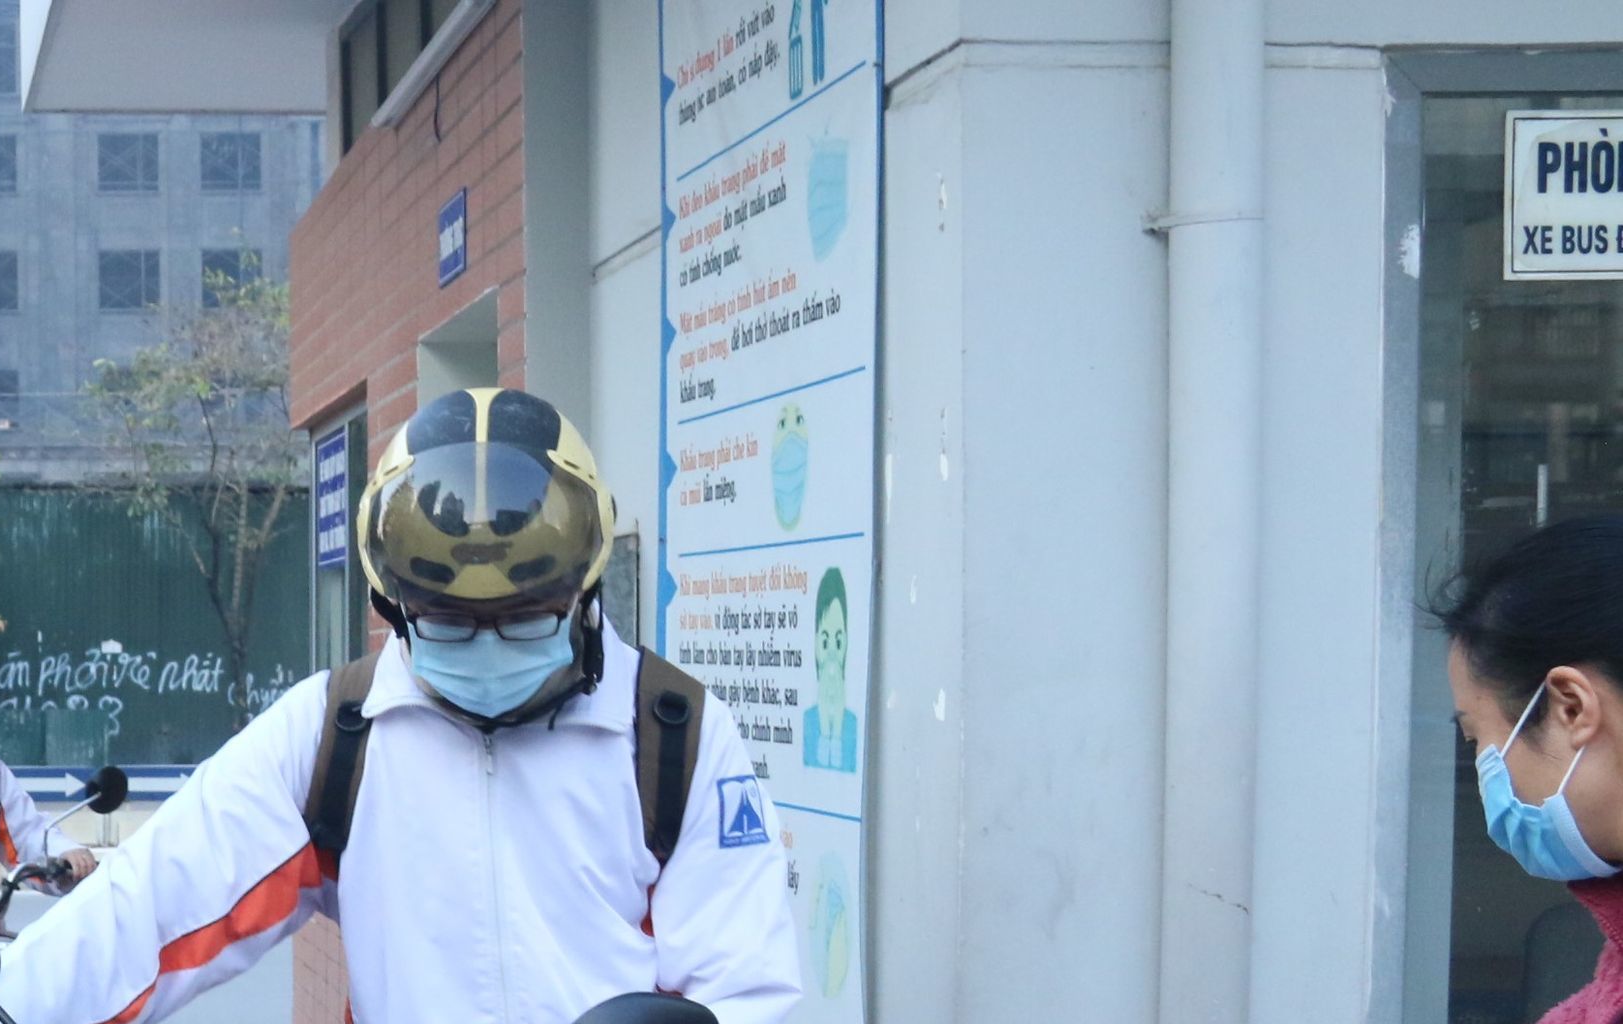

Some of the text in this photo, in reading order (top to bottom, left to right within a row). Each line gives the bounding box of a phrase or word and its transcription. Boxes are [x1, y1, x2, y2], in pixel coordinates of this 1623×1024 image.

[723, 205, 733, 231] do
[767, 175, 787, 208] xanh
[1523, 225, 1554, 255] XE
[1561, 224, 1609, 255] BUS
[791, 311, 801, 330] ra
[826, 288, 842, 318] vào
[764, 607, 776, 634] tay
[782, 643, 803, 668] virus
[784, 688, 798, 706] sau
